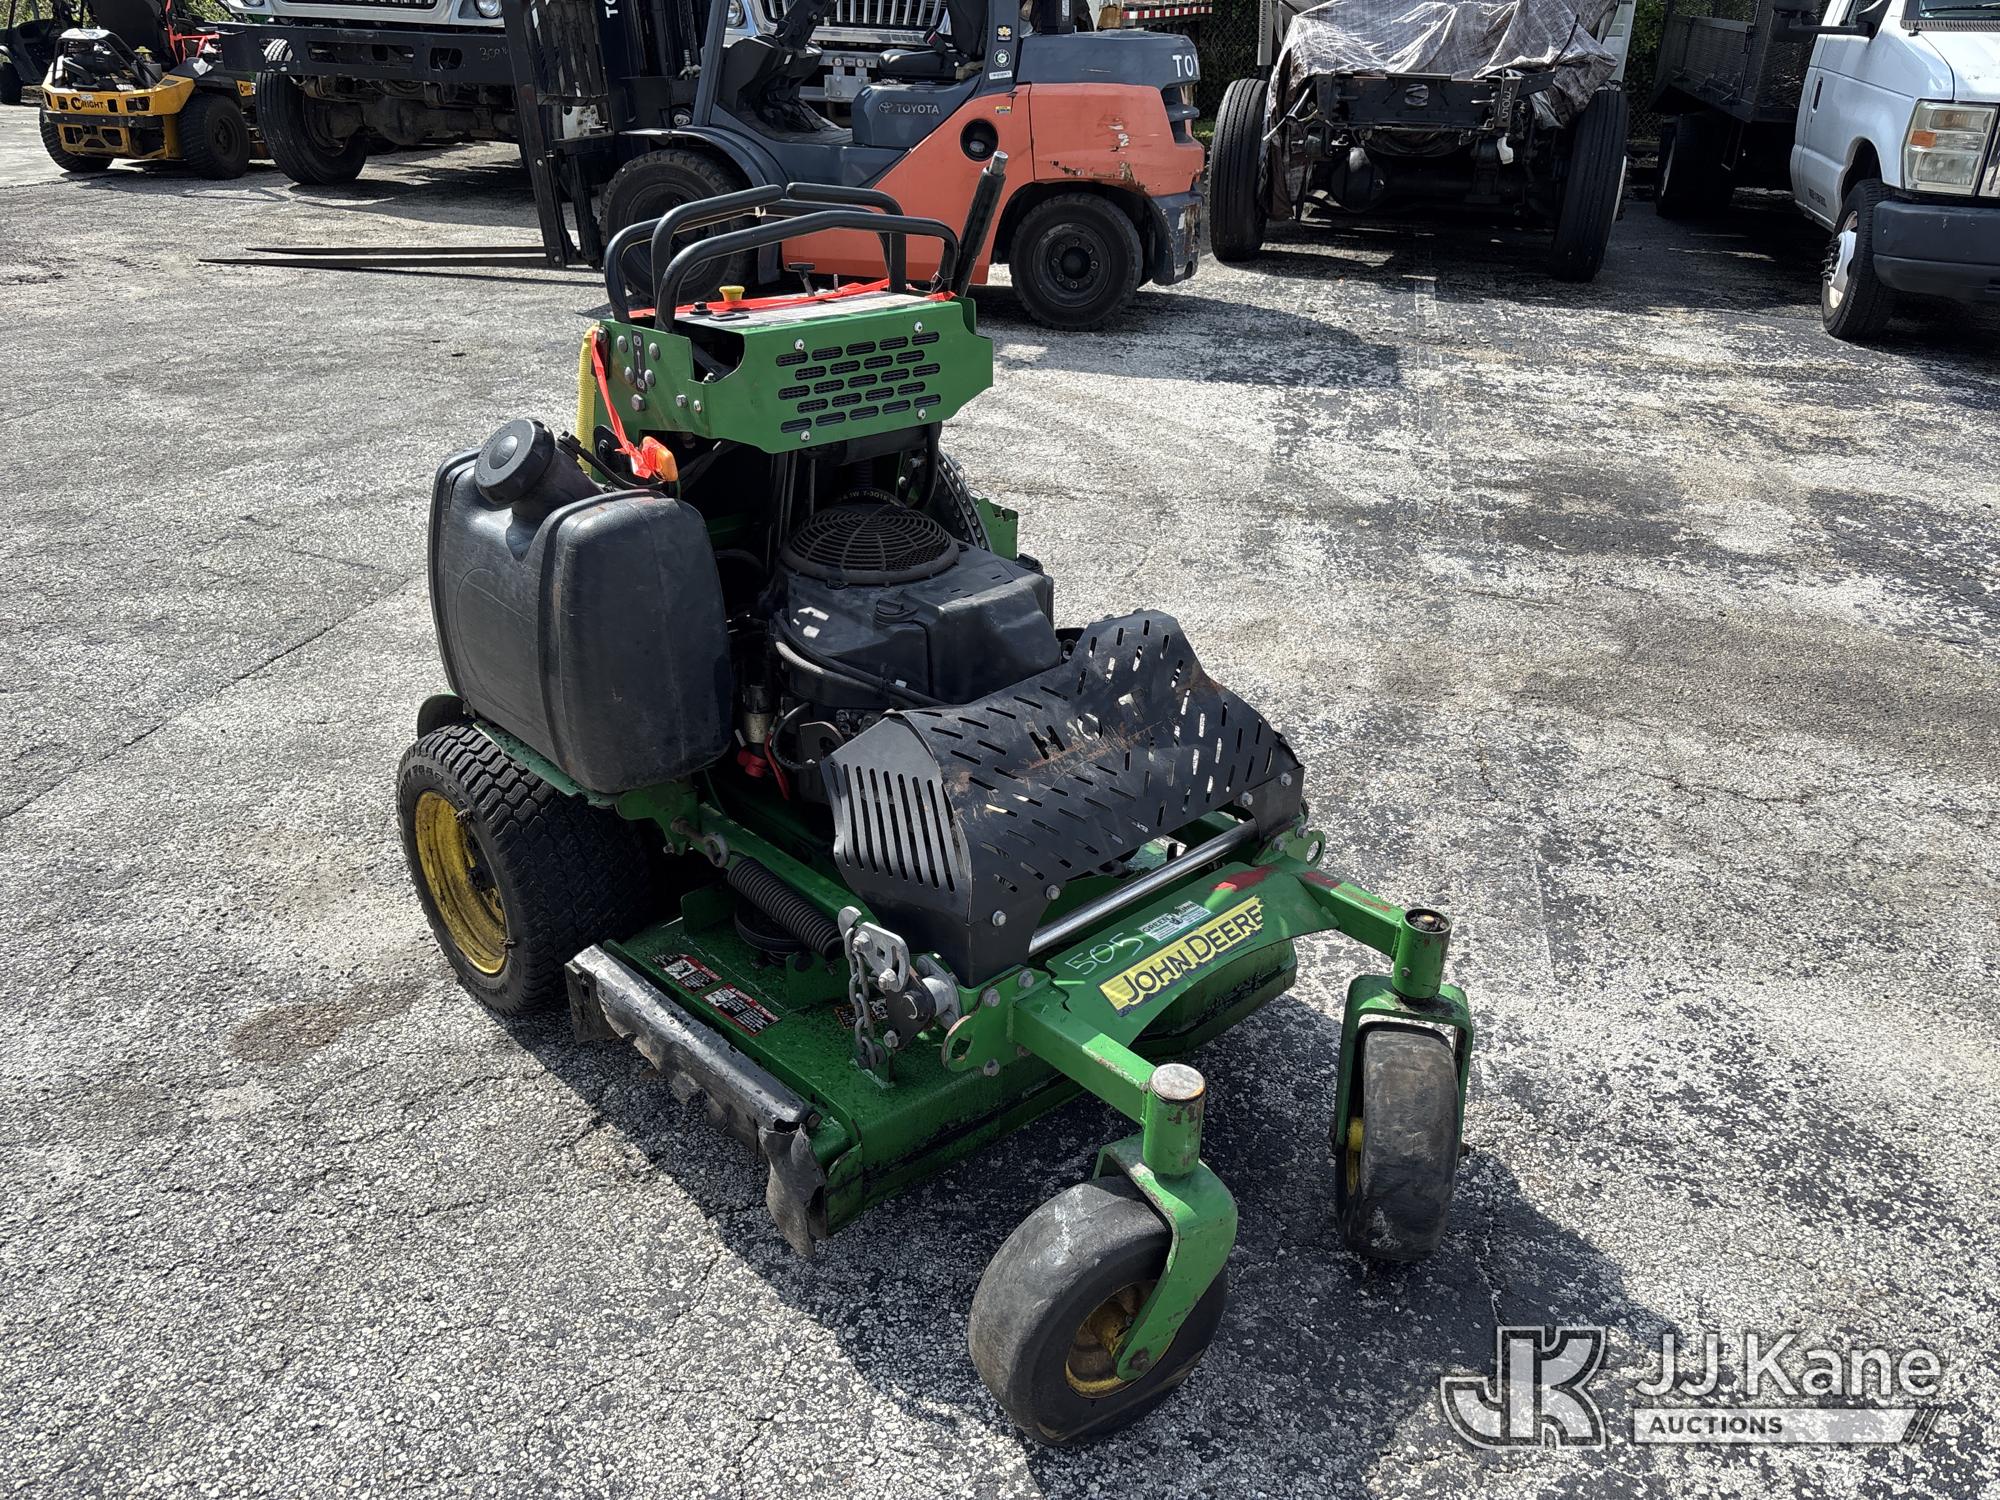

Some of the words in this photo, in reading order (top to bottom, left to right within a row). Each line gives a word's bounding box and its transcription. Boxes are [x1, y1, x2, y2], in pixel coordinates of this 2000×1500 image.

[71, 97, 104, 110] WRIGHT
[896, 103, 940, 114] TOYOTA
[1143, 914, 1171, 932] GREEN
[1064, 932, 1144, 975] 505
[1122, 949, 1192, 1003] JOHN
[1184, 904, 1264, 962] DEERE
